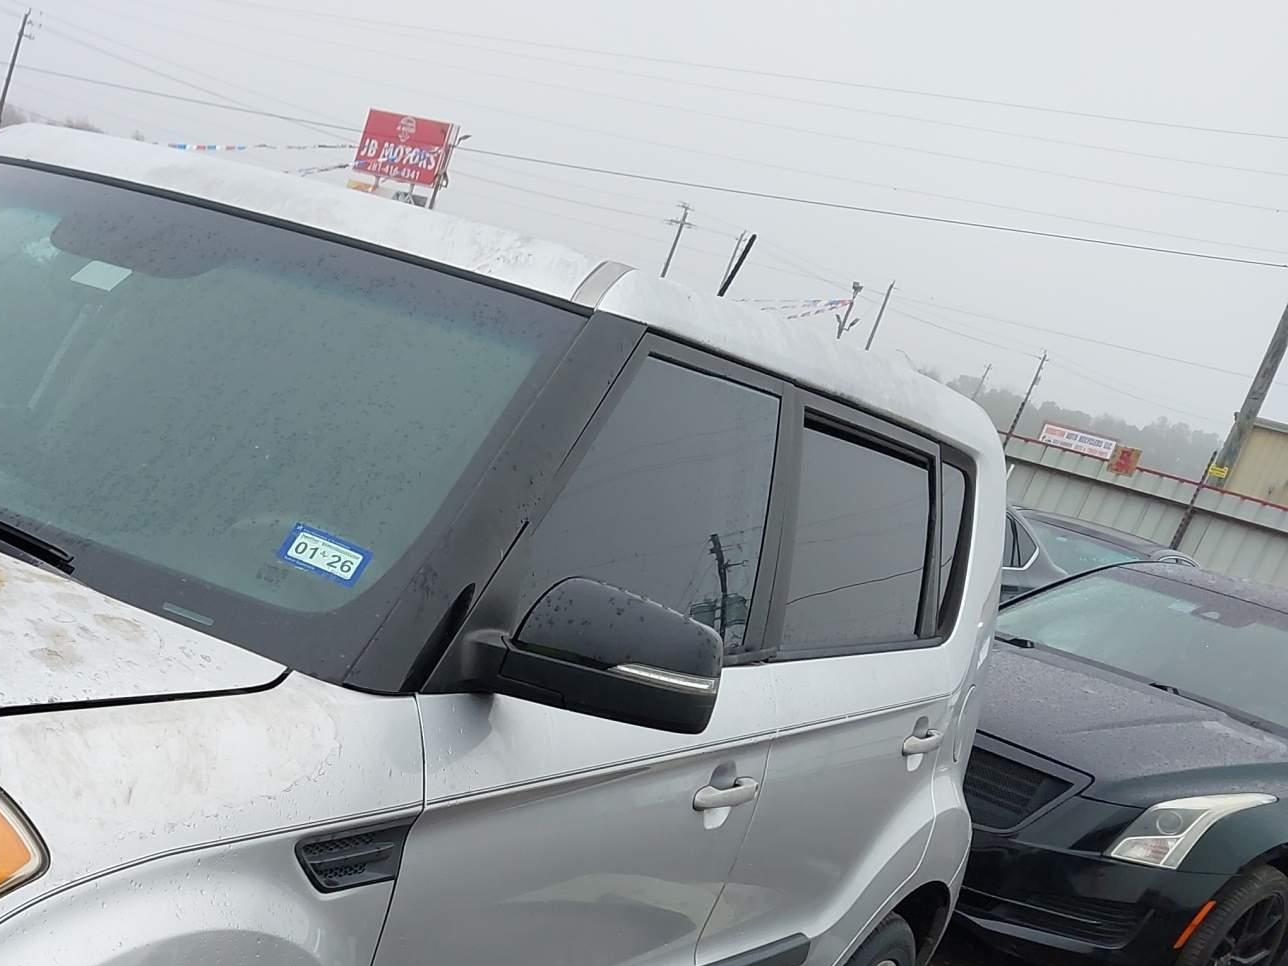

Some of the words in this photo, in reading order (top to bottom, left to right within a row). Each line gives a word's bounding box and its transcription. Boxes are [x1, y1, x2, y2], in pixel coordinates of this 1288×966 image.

[360, 138, 378, 157] JB
[378, 142, 436, 170] MOTORS
[295, 541, 319, 560] 01
[326, 554, 354, 574] 26
